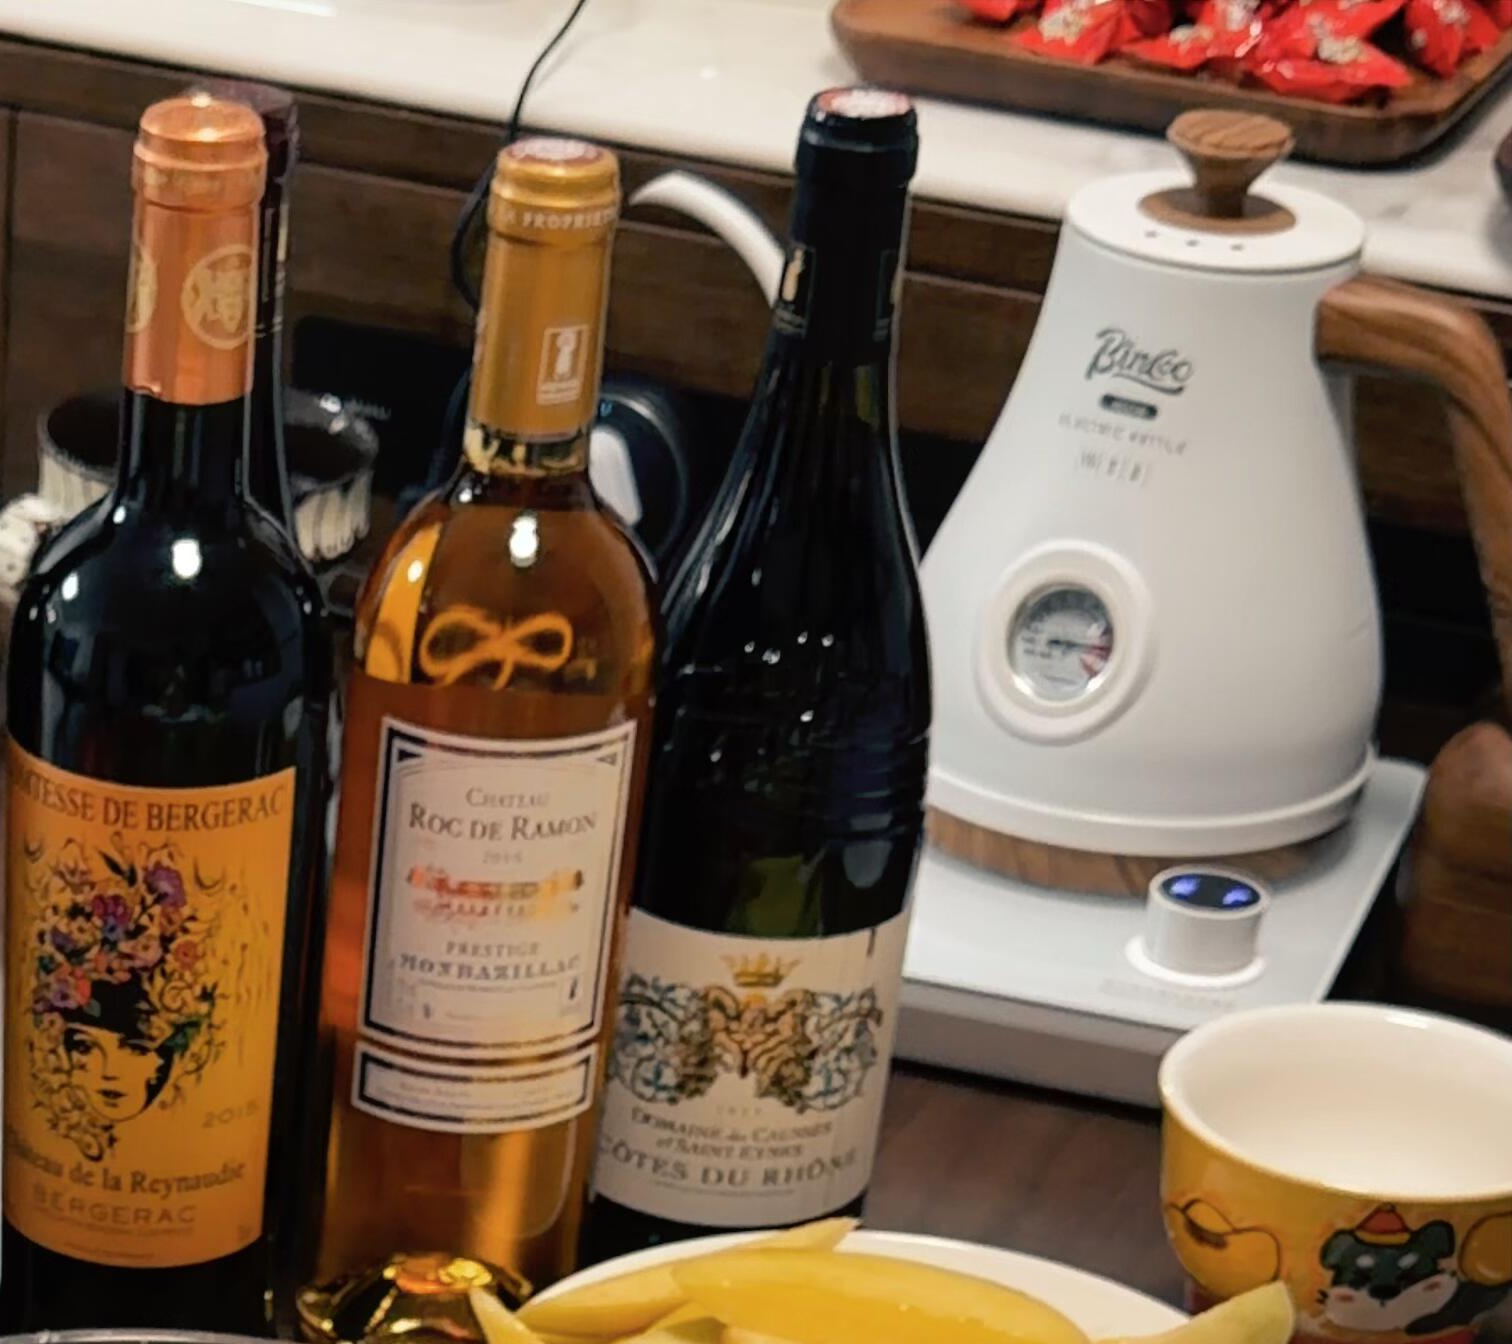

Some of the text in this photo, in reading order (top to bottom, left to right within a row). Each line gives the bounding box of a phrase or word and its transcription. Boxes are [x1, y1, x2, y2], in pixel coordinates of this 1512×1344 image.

[103, 797, 138, 829] DE
[147, 784, 285, 832] BERGERAC
[409, 802, 599, 841] ROC DE RAMON
[701, 1166, 749, 1187] DU
